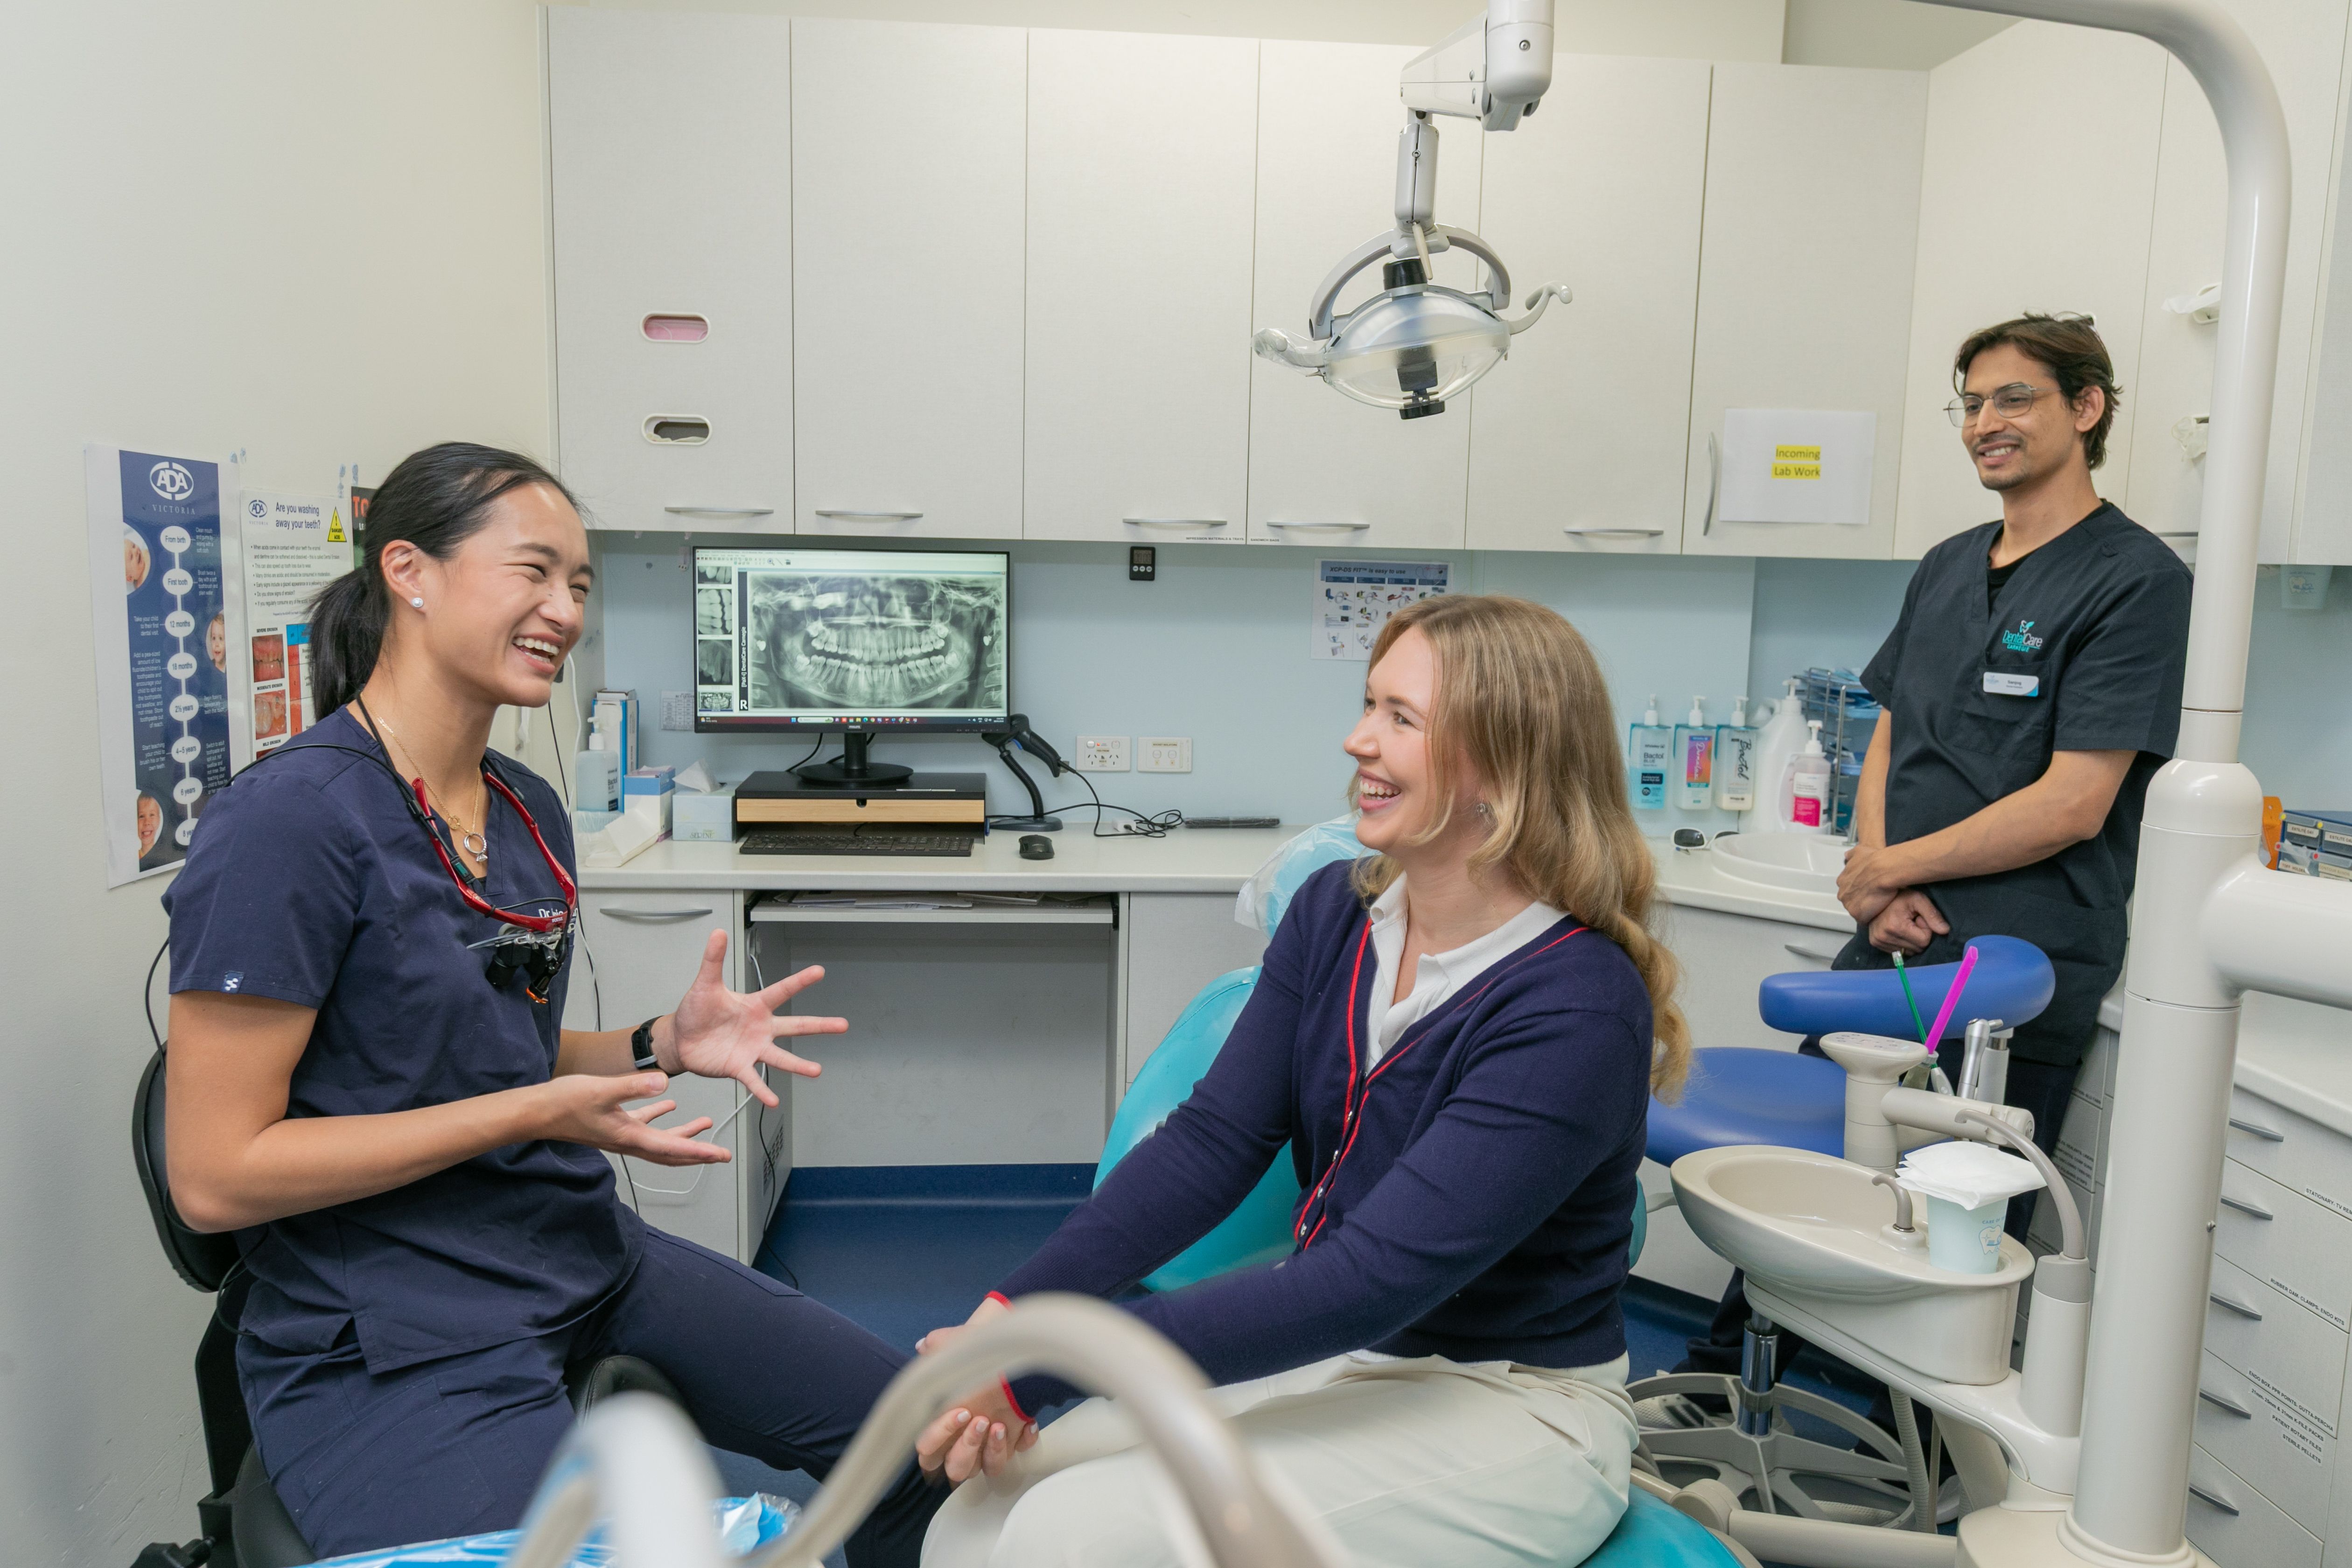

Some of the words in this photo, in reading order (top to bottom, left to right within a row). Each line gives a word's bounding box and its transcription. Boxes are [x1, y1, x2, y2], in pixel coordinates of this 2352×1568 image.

[1776, 448, 1820, 460] Incoming
[1775, 467, 1791, 476] Lab
[1794, 467, 1820, 476] Work
[157, 469, 188, 492] ADA
[152, 504, 195, 515] VICTORIA
[252, 503, 265, 514] ADA
[276, 502, 285, 512] Are
[287, 504, 297, 514] you
[298, 504, 319, 516] washing
[276, 519, 290, 530] away
[292, 520, 303, 531] your
[305, 519, 321, 529] teeth?
[2002, 630, 2043, 647] DentalCare
[740, 700, 748, 710] R
[186, 746, 196, 755] years
[184, 787, 196, 796] years
[2270, 1278, 2288, 1292] RUBBER
[2321, 1308, 2333, 1319] ENDO
[2334, 1316, 2345, 1326] KITS
[2249, 1370, 2261, 1381] ENDO
[2272, 1386, 2281, 1395] PPR
[2299, 1405, 2333, 1431] GUTTA-PERCHA
[2264, 1398, 2276, 1409] 25mm
[2294, 1419, 2308, 1430] K-FILE
[2309, 1428, 2324, 1442] PACKS
[2272, 1414, 2289, 1429] PATIENT
[2290, 1427, 2308, 1442] ROTARY
[2309, 1440, 2322, 1452] FILES
[2282, 1434, 2300, 1449] STERILE
[2301, 1447, 2321, 1463] PELLETS
